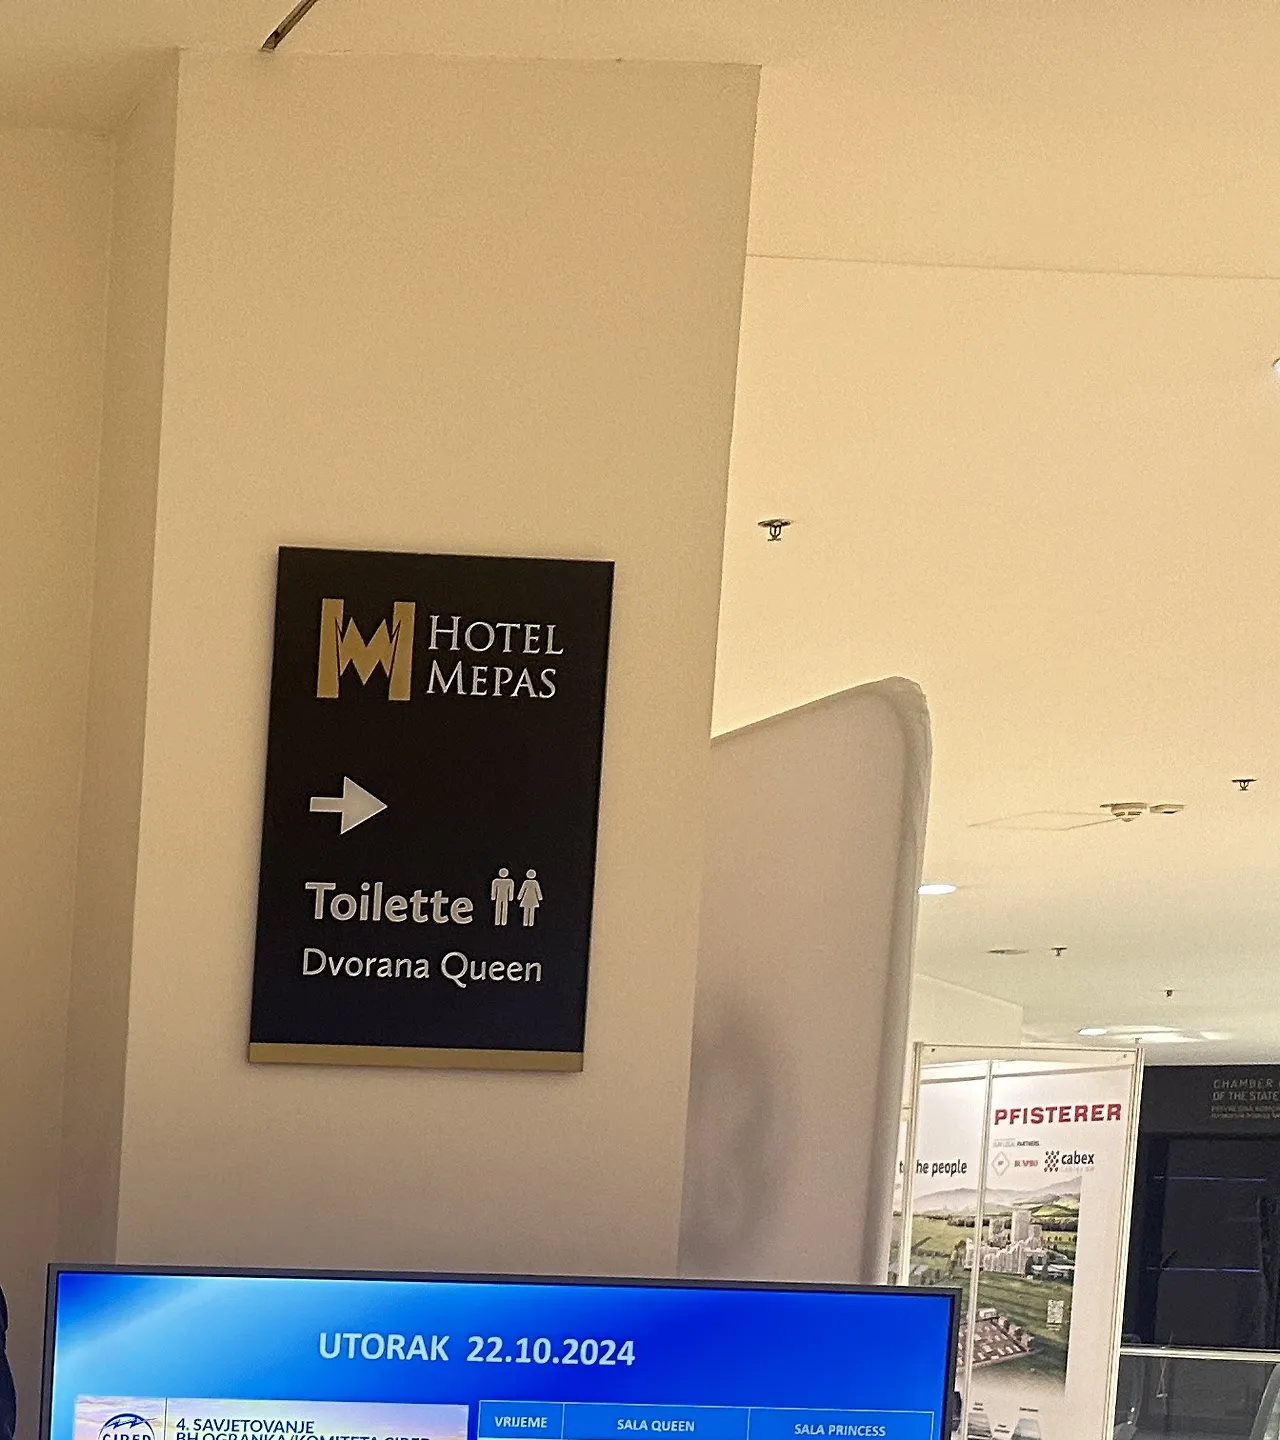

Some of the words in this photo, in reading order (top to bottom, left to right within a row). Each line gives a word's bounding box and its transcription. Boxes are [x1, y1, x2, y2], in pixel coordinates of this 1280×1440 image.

[427, 614, 564, 656] HOTEL
[426, 660, 557, 699] MEPAS
[305, 881, 474, 925] Toilette
[302, 947, 430, 981] Dvorana
[441, 951, 542, 988] Queen
[994, 1103, 1122, 1126] PFISTERER
[932, 1159, 968, 1177] people
[1061, 1150, 1095, 1165] cabex
[319, 1332, 450, 1361] UTORAK
[466, 1336, 636, 1366] 22.10.2024
[176, 1418, 189, 1431] 4.
[193, 1418, 315, 1434] SAVJETOVANJE
[495, 1416, 548, 1429] VRIJEME
[617, 1419, 648, 1432] SALA
[651, 1419, 695, 1433] QUEEN
[794, 1423, 825, 1436] SALA
[828, 1424, 886, 1437] PRINCESS
